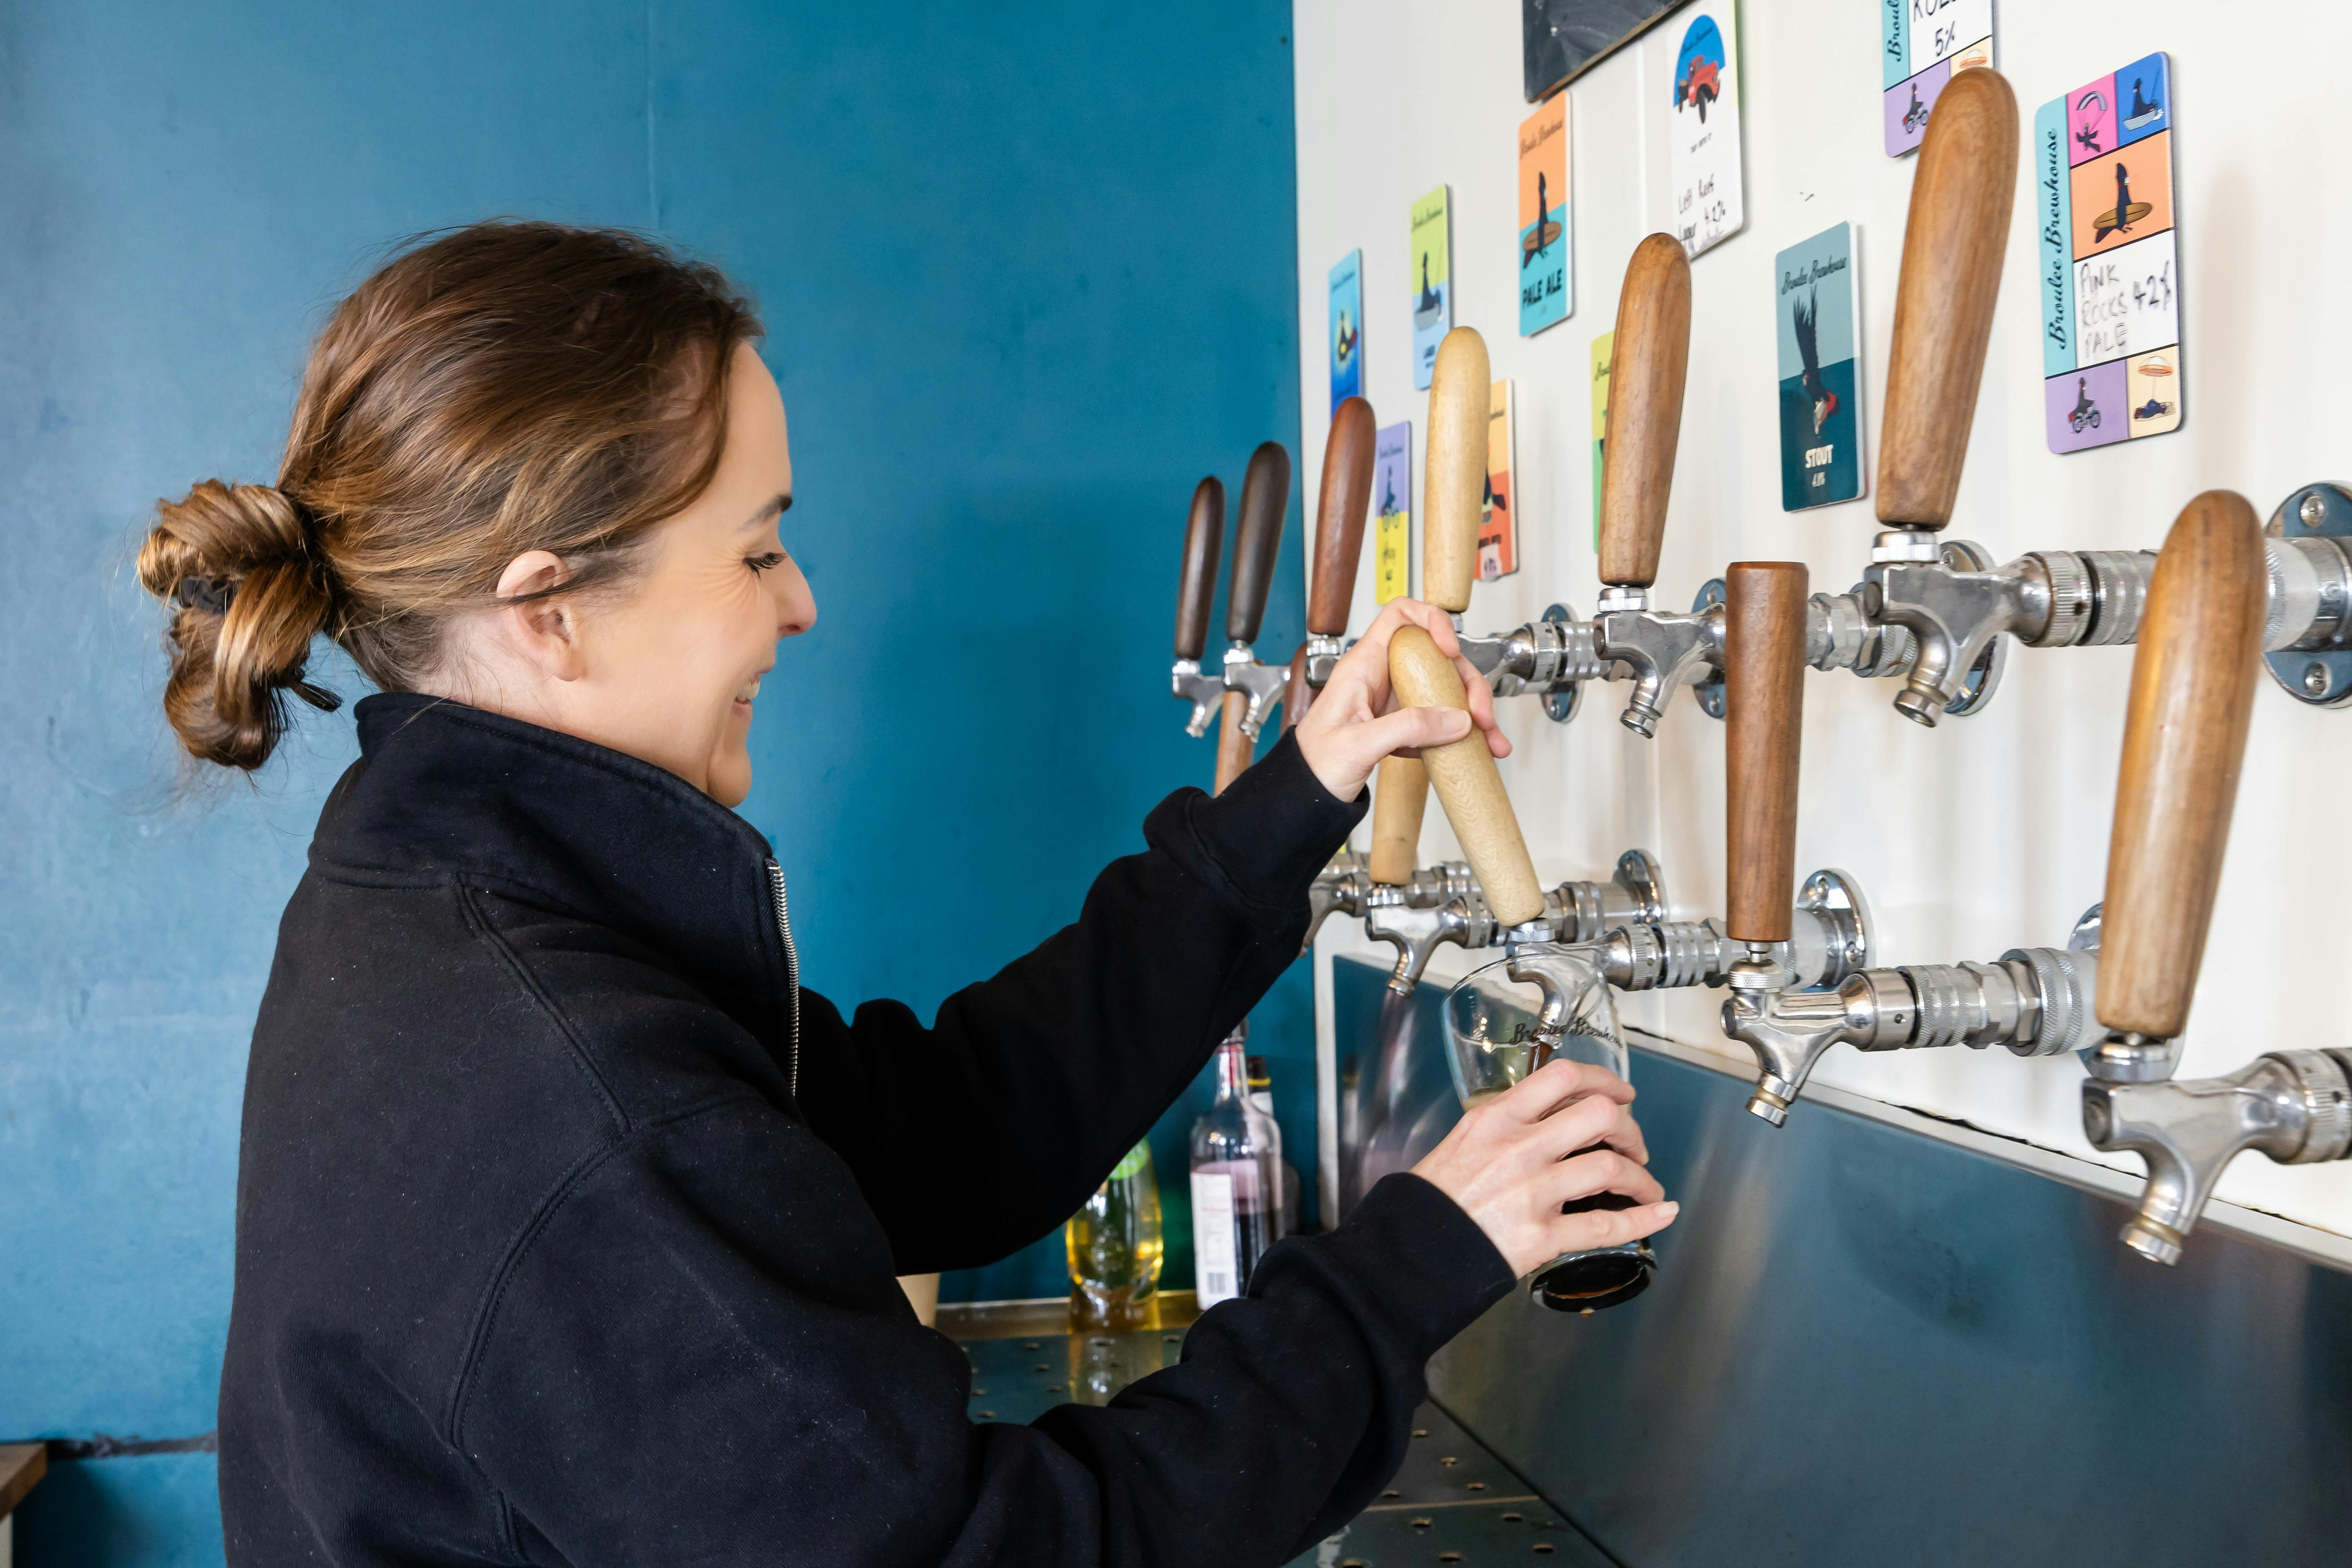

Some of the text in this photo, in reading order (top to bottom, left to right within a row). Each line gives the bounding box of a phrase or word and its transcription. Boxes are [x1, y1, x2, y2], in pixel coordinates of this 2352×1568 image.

[1887, 0, 1902, 62] Broul
[1935, 21, 1955, 57] 5%
[2043, 128, 2067, 350] Broulee Brewhouse
[1522, 268, 1562, 310] PALE ALE
[1805, 444, 1834, 468] STOUT
